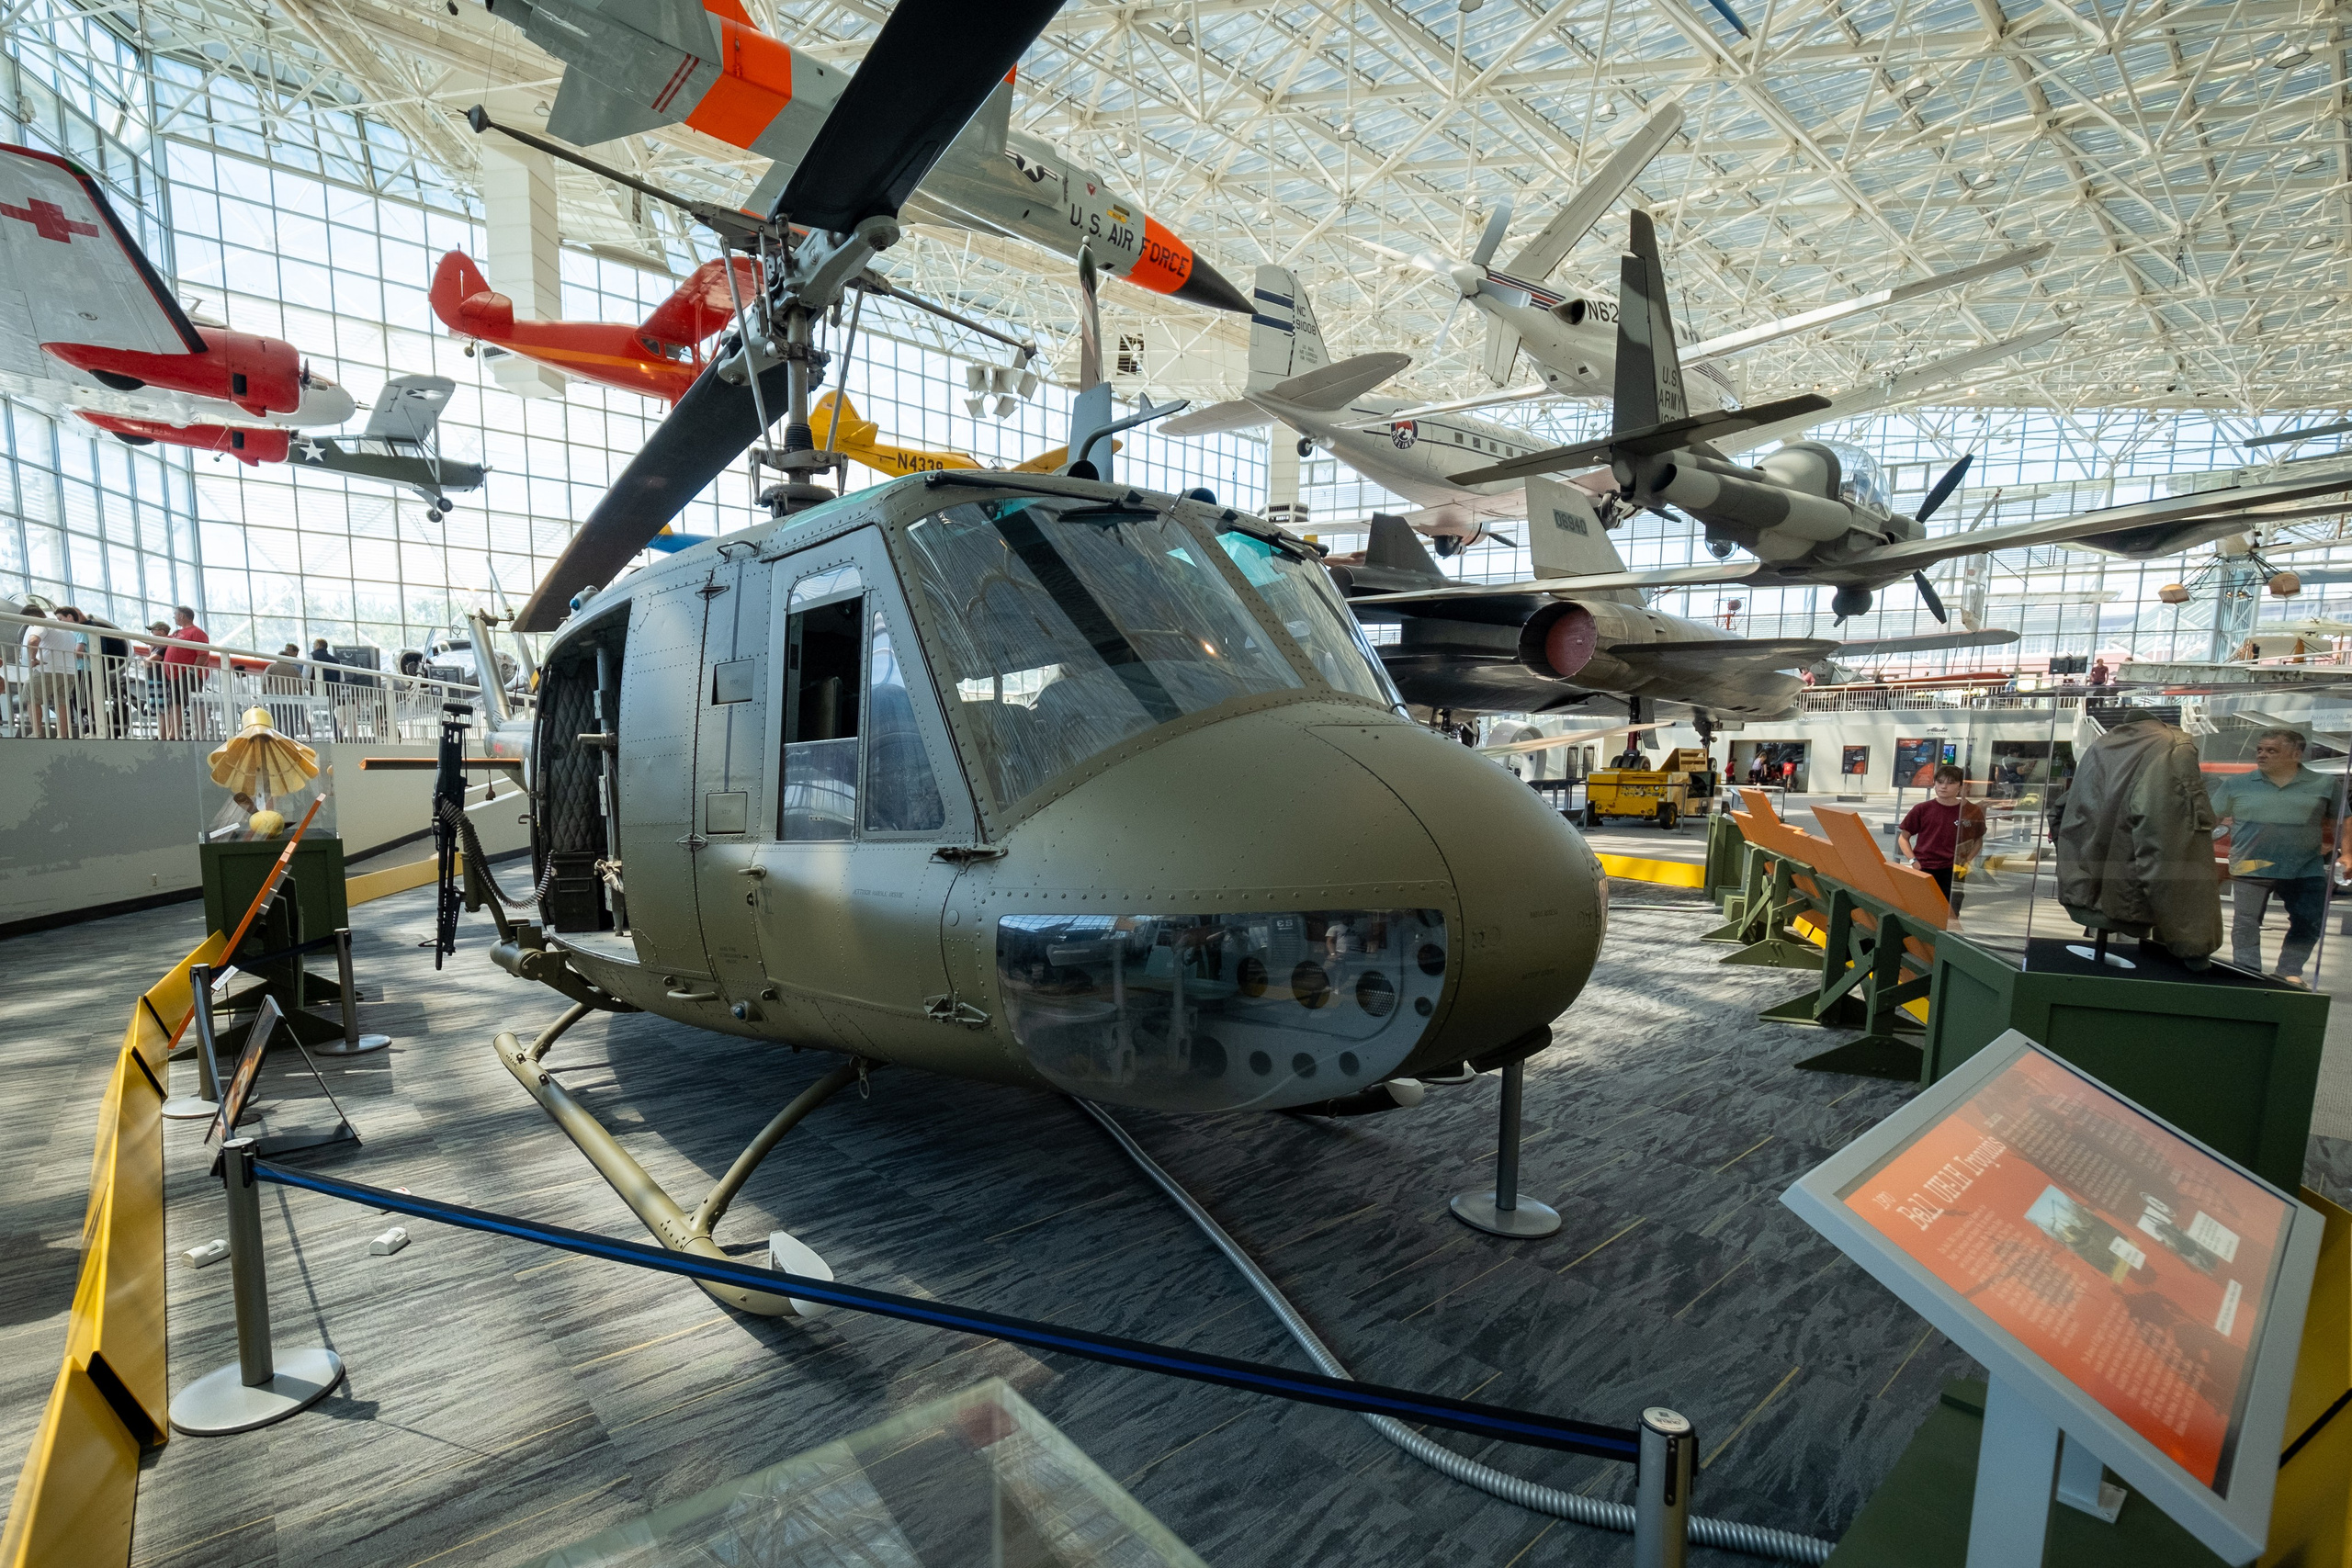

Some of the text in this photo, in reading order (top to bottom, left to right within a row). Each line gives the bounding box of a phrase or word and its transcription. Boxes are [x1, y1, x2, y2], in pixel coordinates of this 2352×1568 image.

[1107, 223, 1134, 252] AIR
[1138, 236, 1190, 277] FORCE
[1296, 304, 1306, 318] NC
[1658, 389, 1681, 412] ARMY
[1459, 417, 1499, 437] ALASKA
[1555, 512, 1588, 534] 06940
[1896, 1135, 2007, 1231] Bell UH-1H Iroquois
